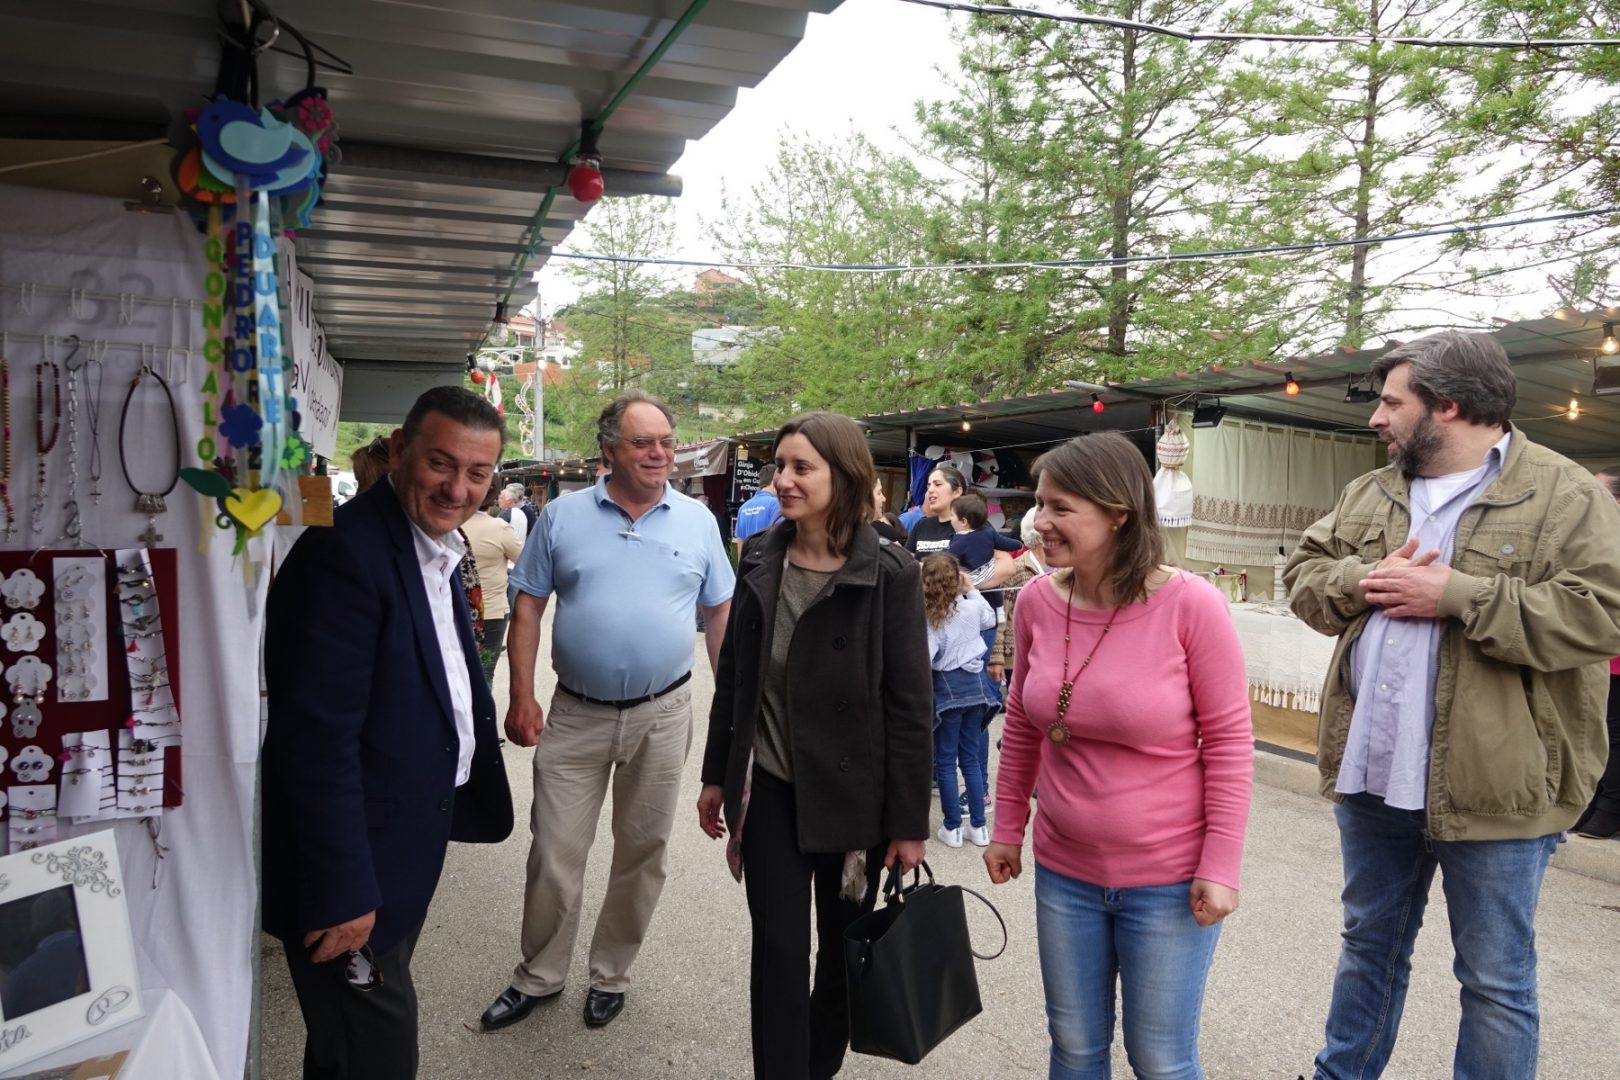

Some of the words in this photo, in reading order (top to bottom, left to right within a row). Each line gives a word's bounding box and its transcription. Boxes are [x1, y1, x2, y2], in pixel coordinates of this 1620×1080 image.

[231, 222, 255, 372] PEDRO
[254, 233, 281, 423] DUARTE
[737, 461, 754, 470] Ginja
